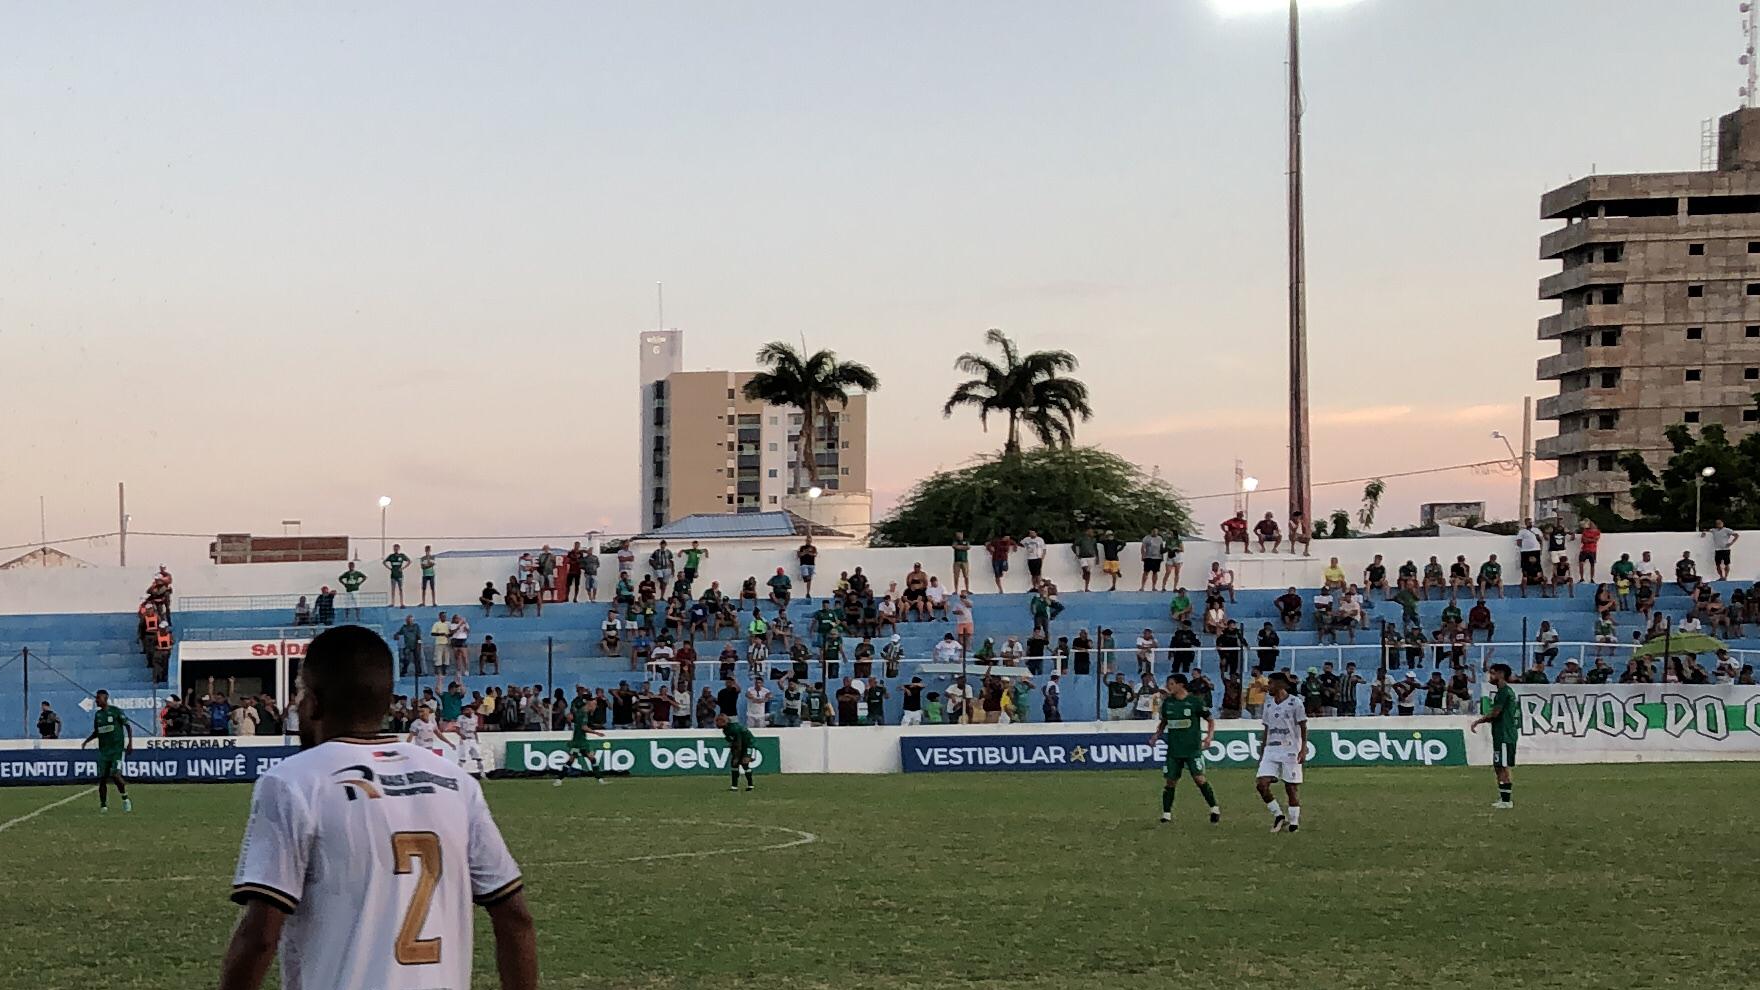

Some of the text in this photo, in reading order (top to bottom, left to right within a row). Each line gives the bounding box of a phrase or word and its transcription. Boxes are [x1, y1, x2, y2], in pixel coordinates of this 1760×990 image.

[1492, 692, 1648, 740] RAVOS
[1661, 694, 1730, 741] DO
[146, 738, 238, 750] SECRETARIA DE
[649, 739, 763, 774] betvp
[915, 739, 1168, 766] VESTIBULAR UNIPÊ
[1331, 731, 1448, 765] betvip
[75, 760, 178, 777] PAIBANO
[186, 753, 247, 777] UNIPÊ
[392, 830, 443, 966] 2
